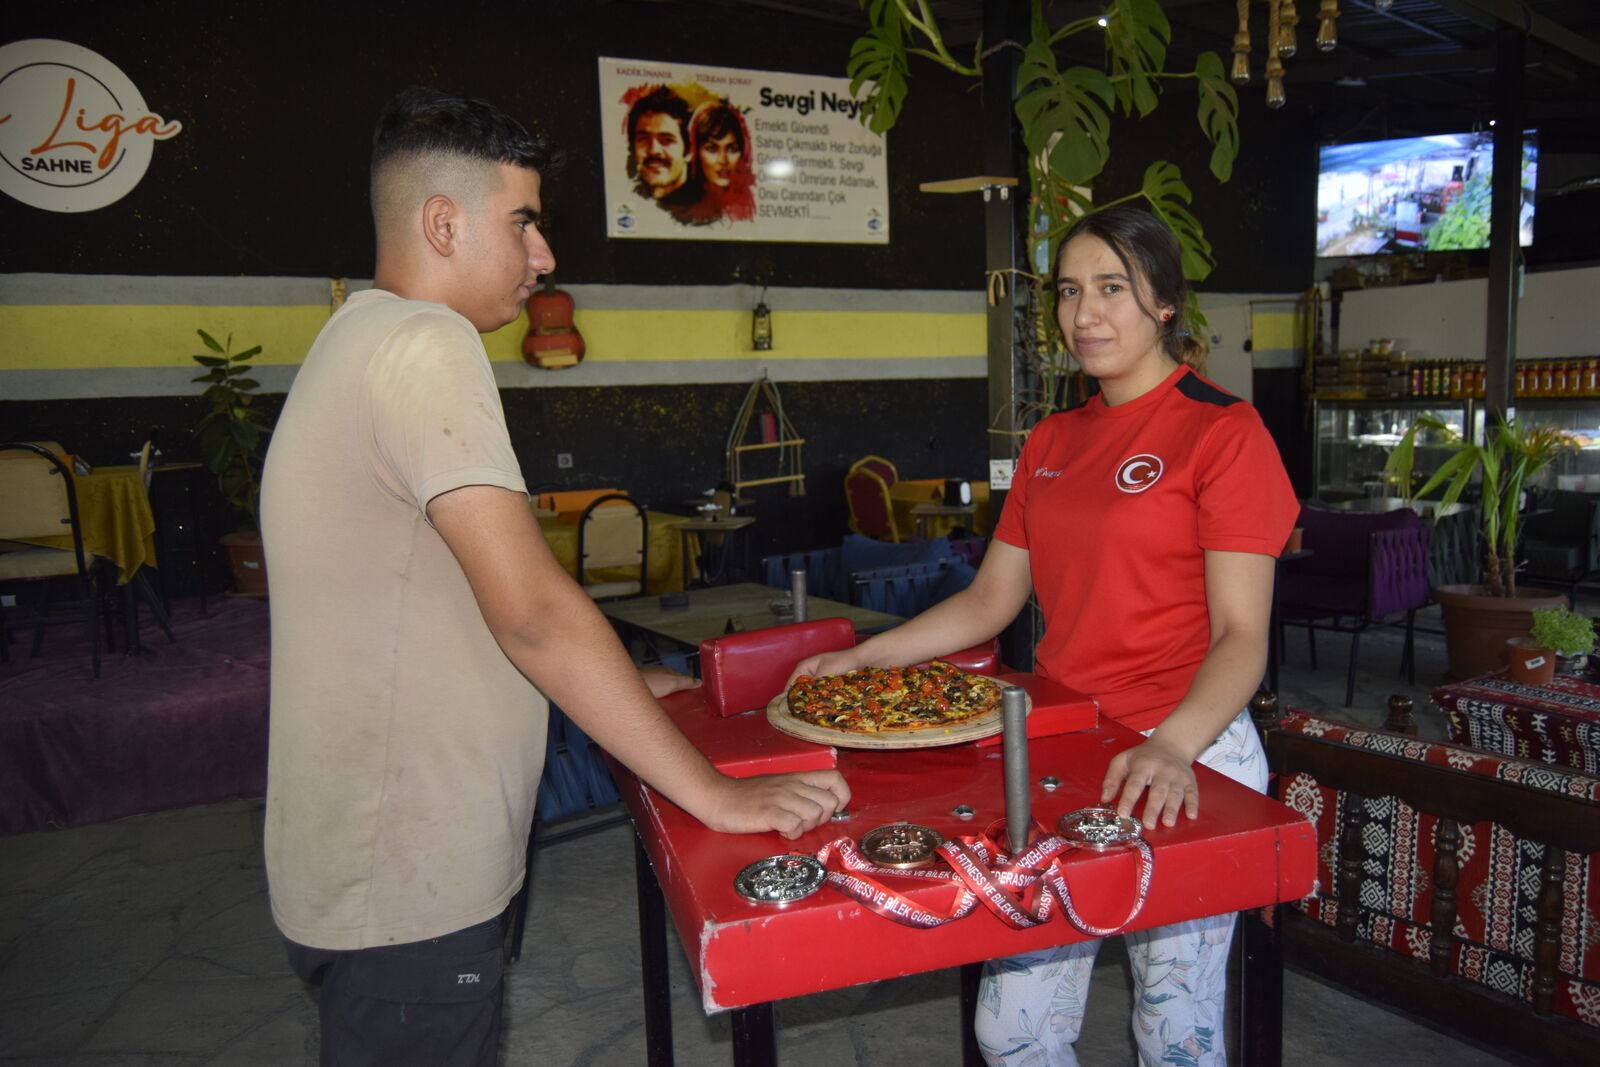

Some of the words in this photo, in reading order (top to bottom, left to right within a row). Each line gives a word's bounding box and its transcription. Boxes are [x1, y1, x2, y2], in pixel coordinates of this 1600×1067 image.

[760, 87, 815, 115] Sevgi
[30, 77, 177, 171] Liga
[756, 136, 783, 149] Sahip
[830, 141, 846, 152] Her
[22, 157, 93, 173] SAHNE
[839, 158, 865, 173] Sevgi
[758, 187, 779, 200] Onu
[828, 190, 847, 205] Çok
[913, 869, 925, 877] VE
[955, 853, 987, 886] FITNESS
[982, 882, 997, 896] VE
[990, 893, 1016, 916] BİLEK
[872, 889, 887, 905] VE
[884, 896, 912, 918] BİLEK
